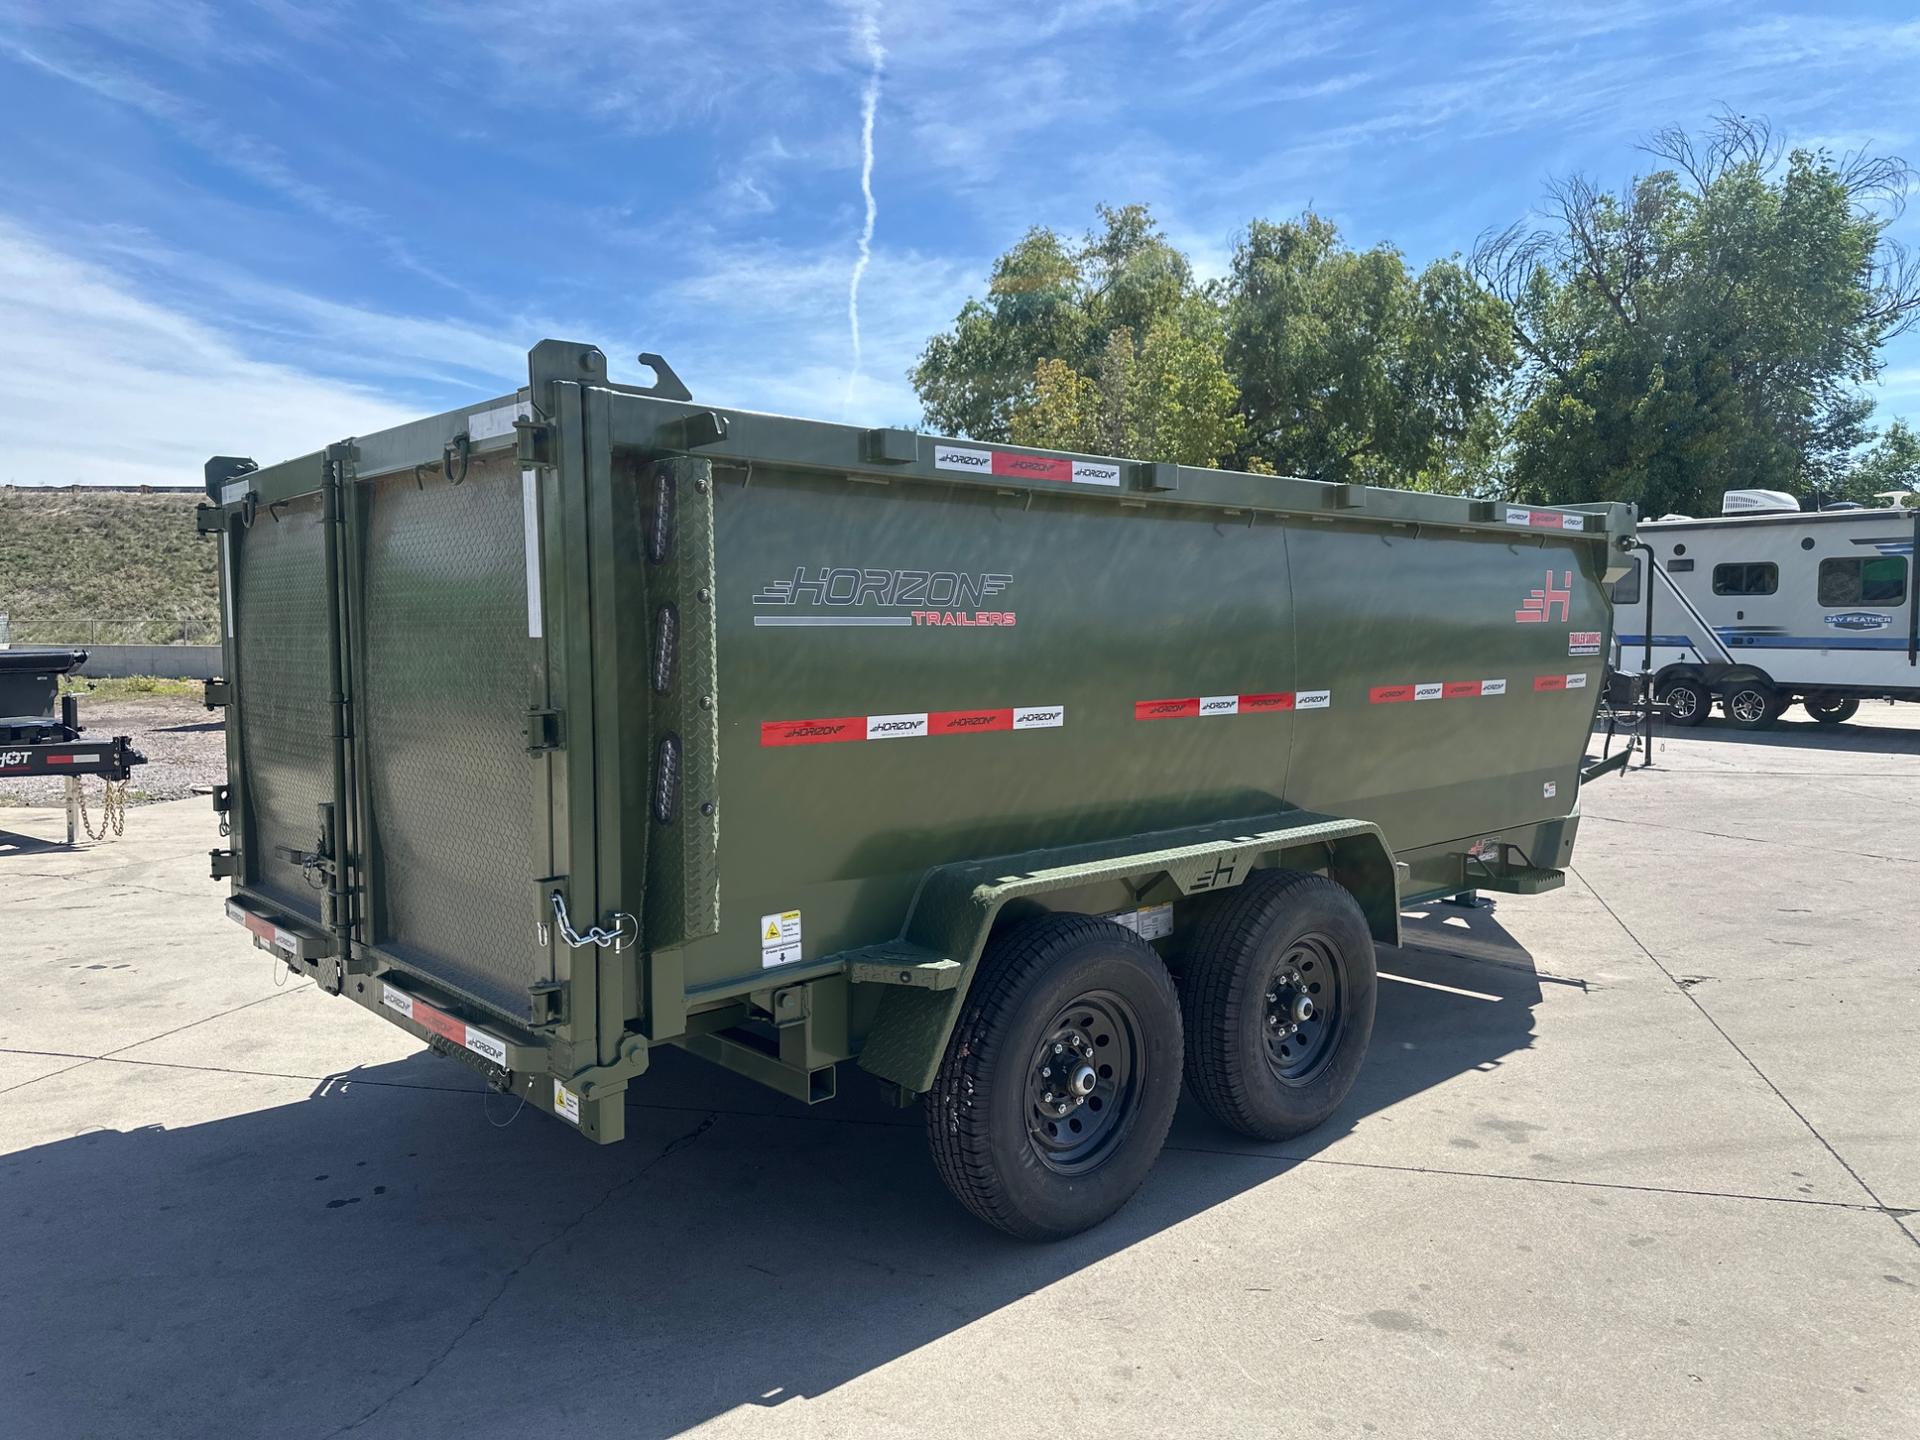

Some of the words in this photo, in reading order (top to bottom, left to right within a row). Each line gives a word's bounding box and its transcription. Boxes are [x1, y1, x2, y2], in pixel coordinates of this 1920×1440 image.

[945, 453, 985, 467] HORIZON
[1015, 461, 1050, 472] HORIZON
[1079, 468, 1113, 479] HORIZON
[787, 566, 987, 607] HORIZON
[911, 611, 1017, 626] TRAILERS
[1155, 705, 1183, 714] HORIZON
[1206, 702, 1234, 710] HORIZON
[1302, 695, 1326, 703] HORIZON
[791, 726, 839, 737] HORIZON
[877, 721, 920, 732] HORIZON
[952, 716, 993, 727] HORIZON
[1022, 712, 1058, 721] HORIZON
[471, 1038, 502, 1059] HORIZON
